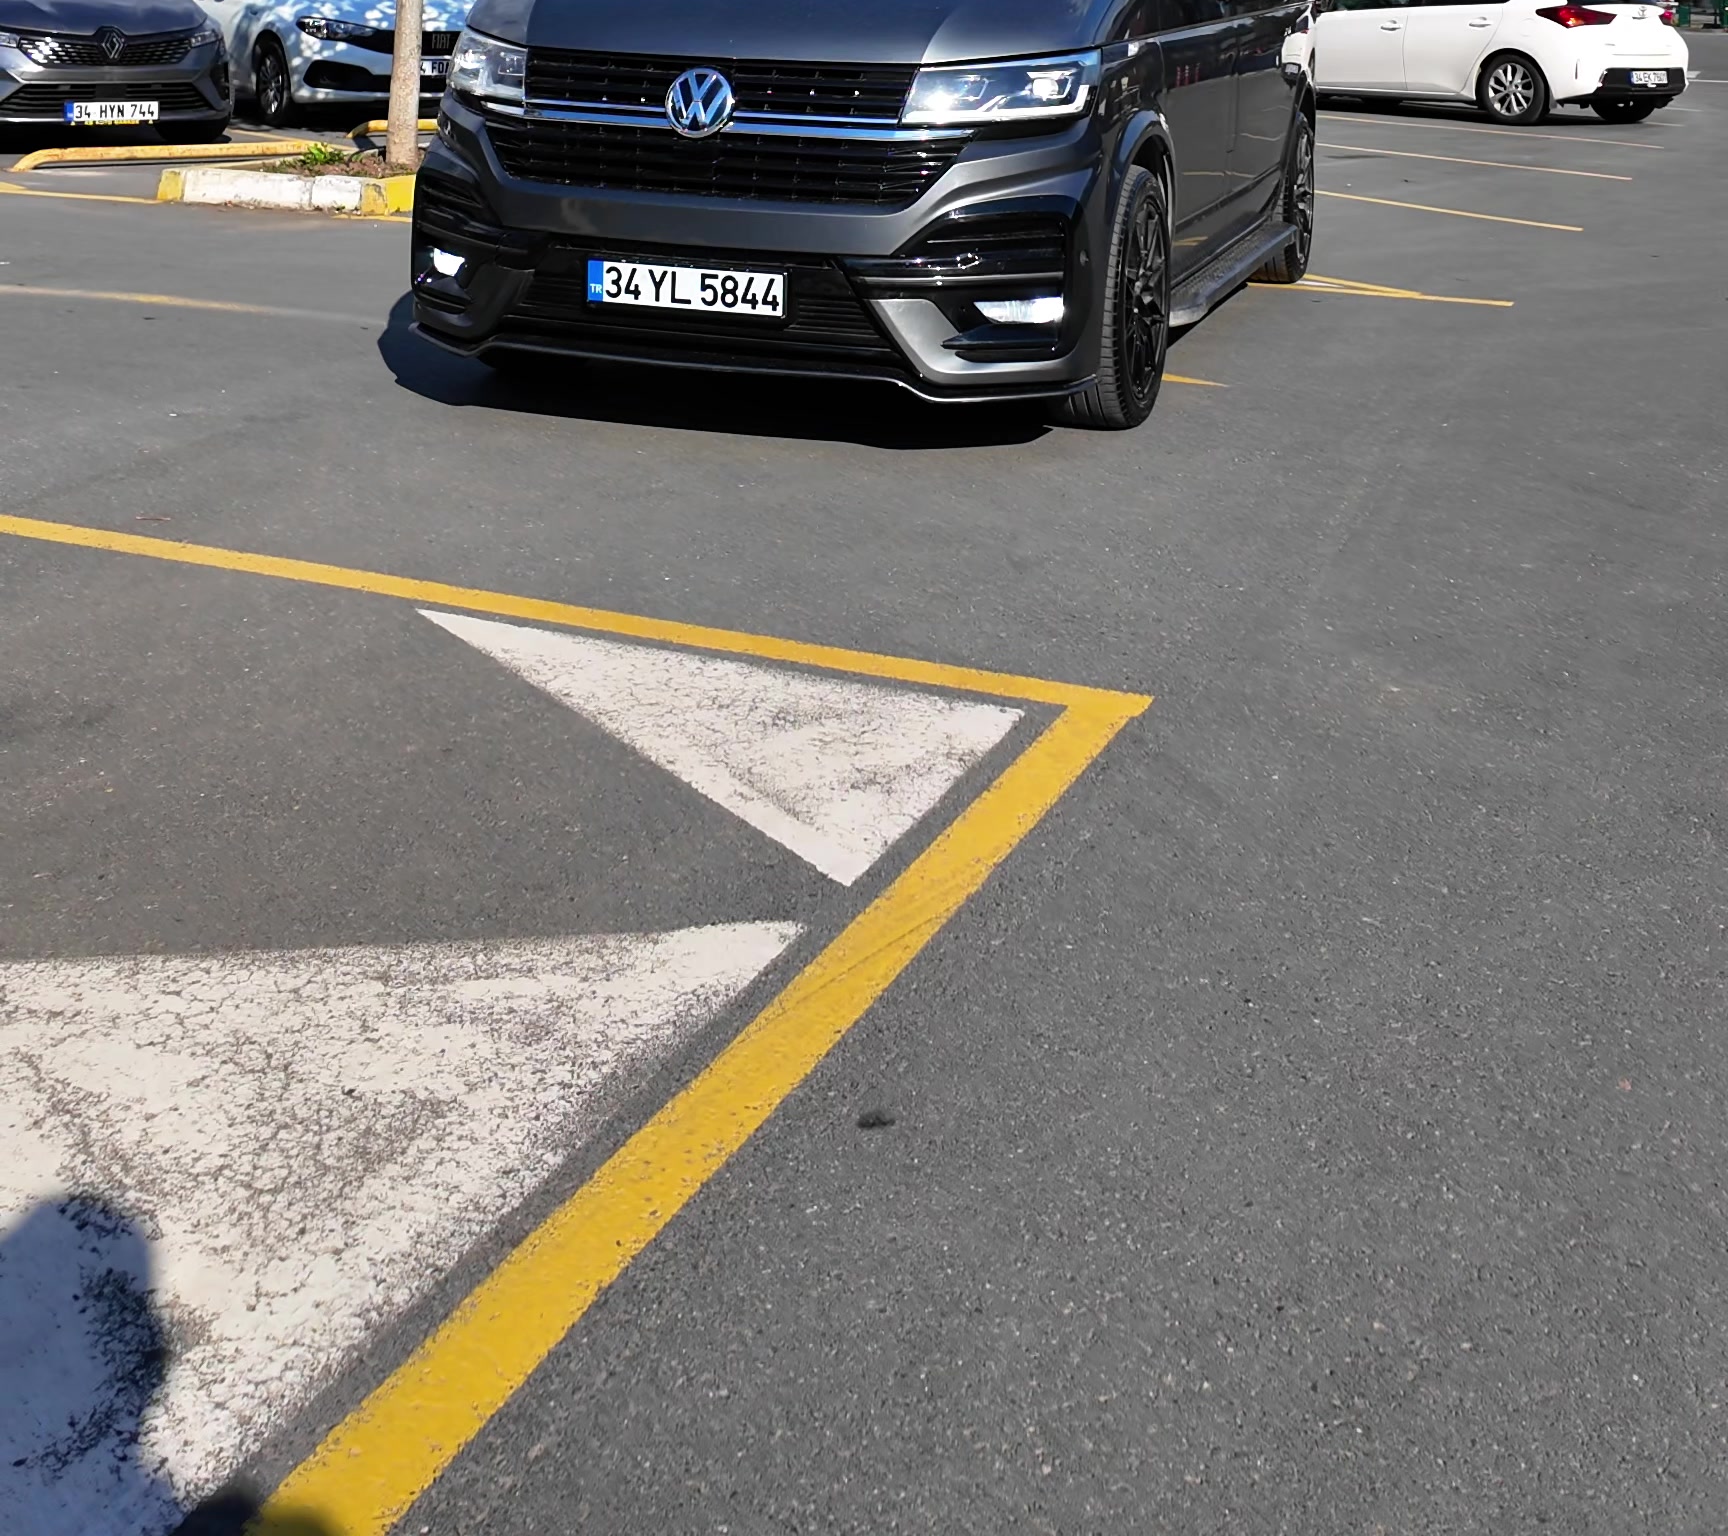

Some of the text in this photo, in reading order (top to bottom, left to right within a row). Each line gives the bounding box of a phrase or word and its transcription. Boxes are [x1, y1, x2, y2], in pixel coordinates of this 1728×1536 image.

[432, 33, 450, 49] FIAT
[75, 103, 155, 119] 34 HYN 744
[667, 69, 732, 136] VW
[590, 266, 780, 312] TR 34 YL 5844
